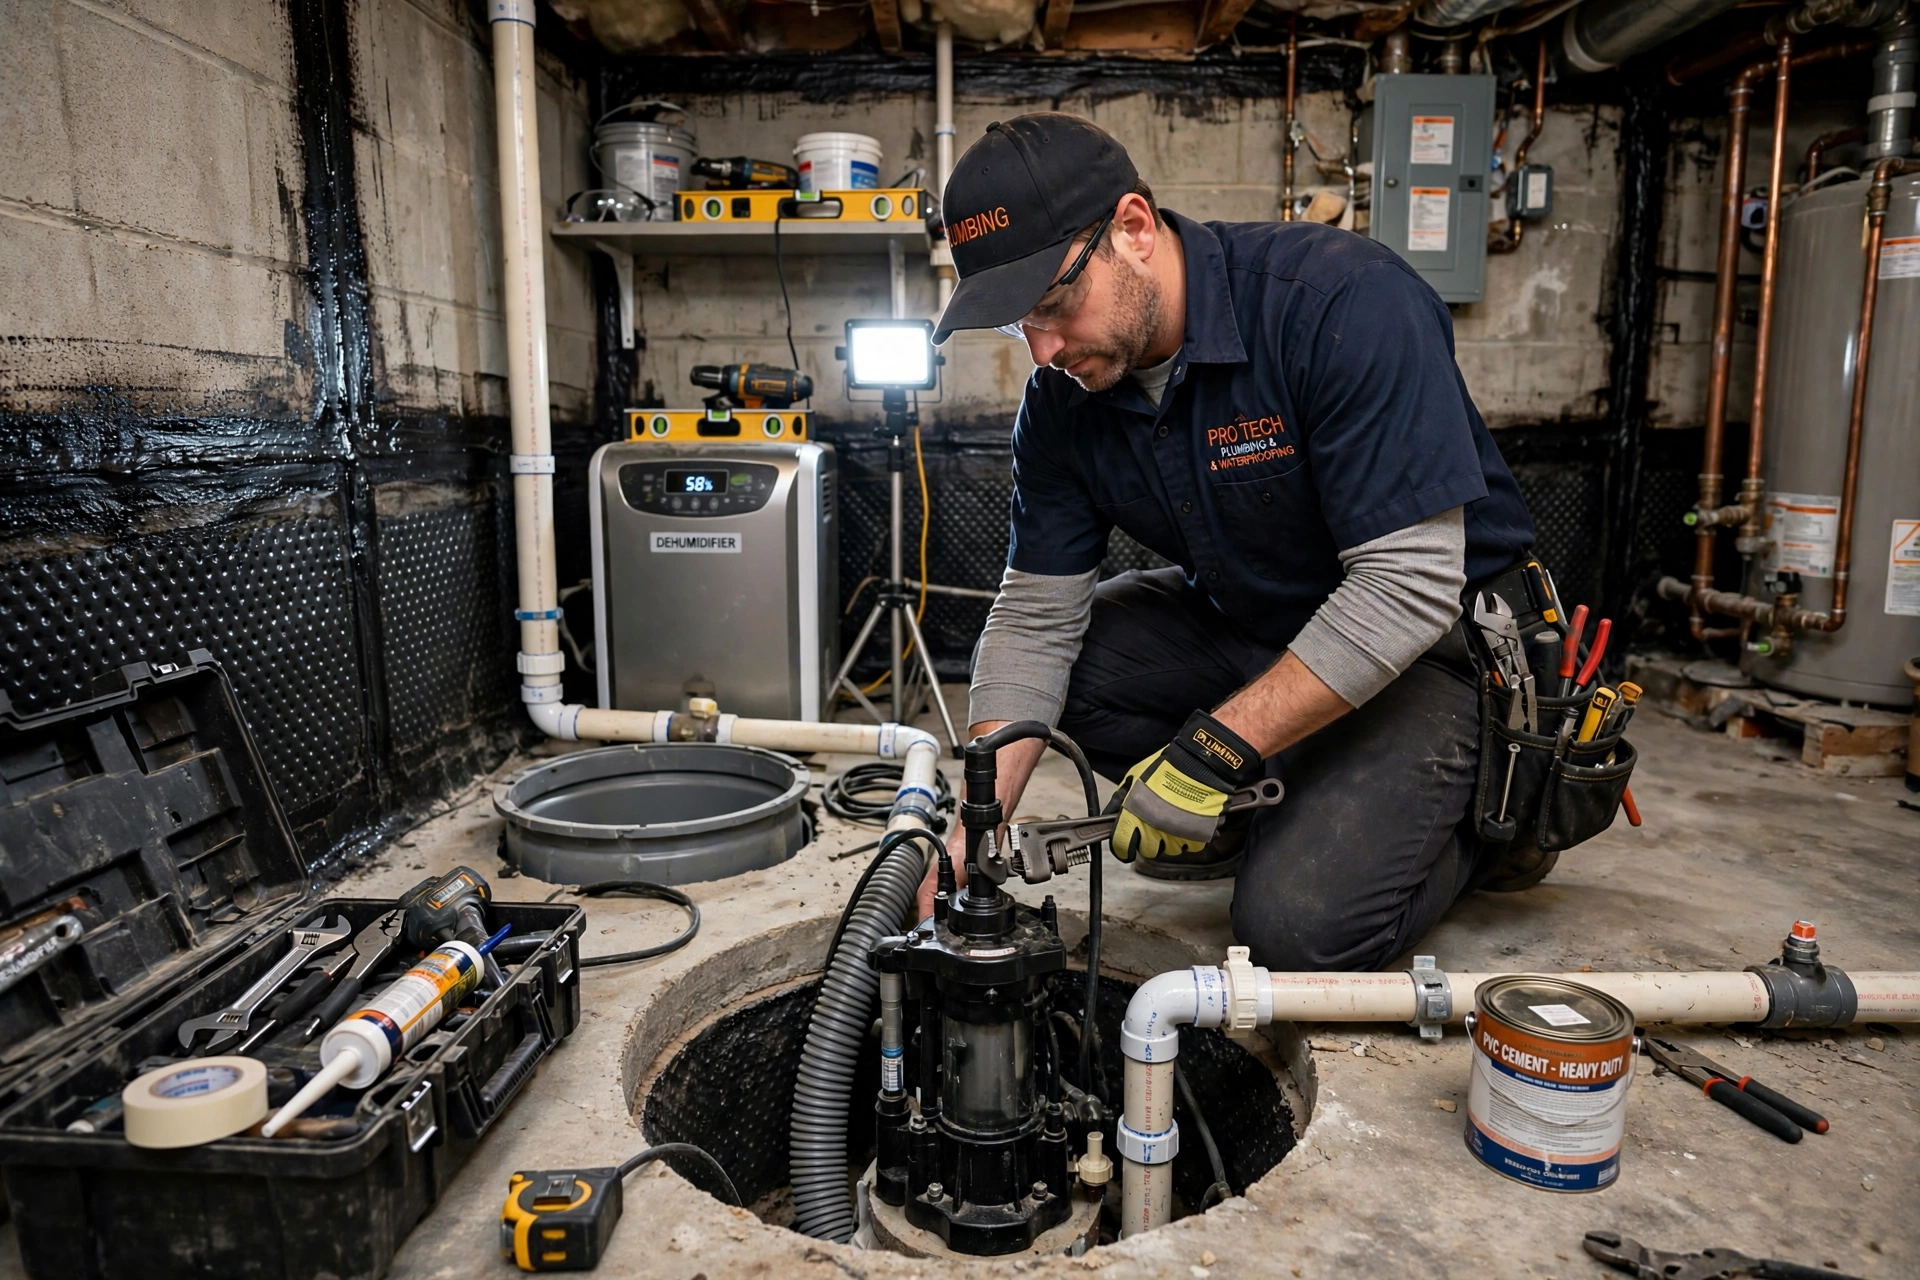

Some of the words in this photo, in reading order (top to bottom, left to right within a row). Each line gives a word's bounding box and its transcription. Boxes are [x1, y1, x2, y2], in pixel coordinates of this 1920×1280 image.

[946, 207, 1009, 247] LUMBING
[1207, 425, 1239, 447] PRO
[1238, 415, 1284, 440] TECH
[1209, 460, 1219, 471] &
[1218, 445, 1295, 469] WATERPROOFING
[1220, 439, 1268, 457] PLUMBING
[1268, 437, 1277, 447] &
[685, 476, 714, 492] 58%
[656, 537, 736, 549] DEHUMIDIFIER
[1483, 1031, 1500, 1055] PVC
[1501, 1043, 1550, 1075] CEMENT
[1559, 1060, 1600, 1079] HEAVY
[1600, 1055, 1624, 1078] DUTY
